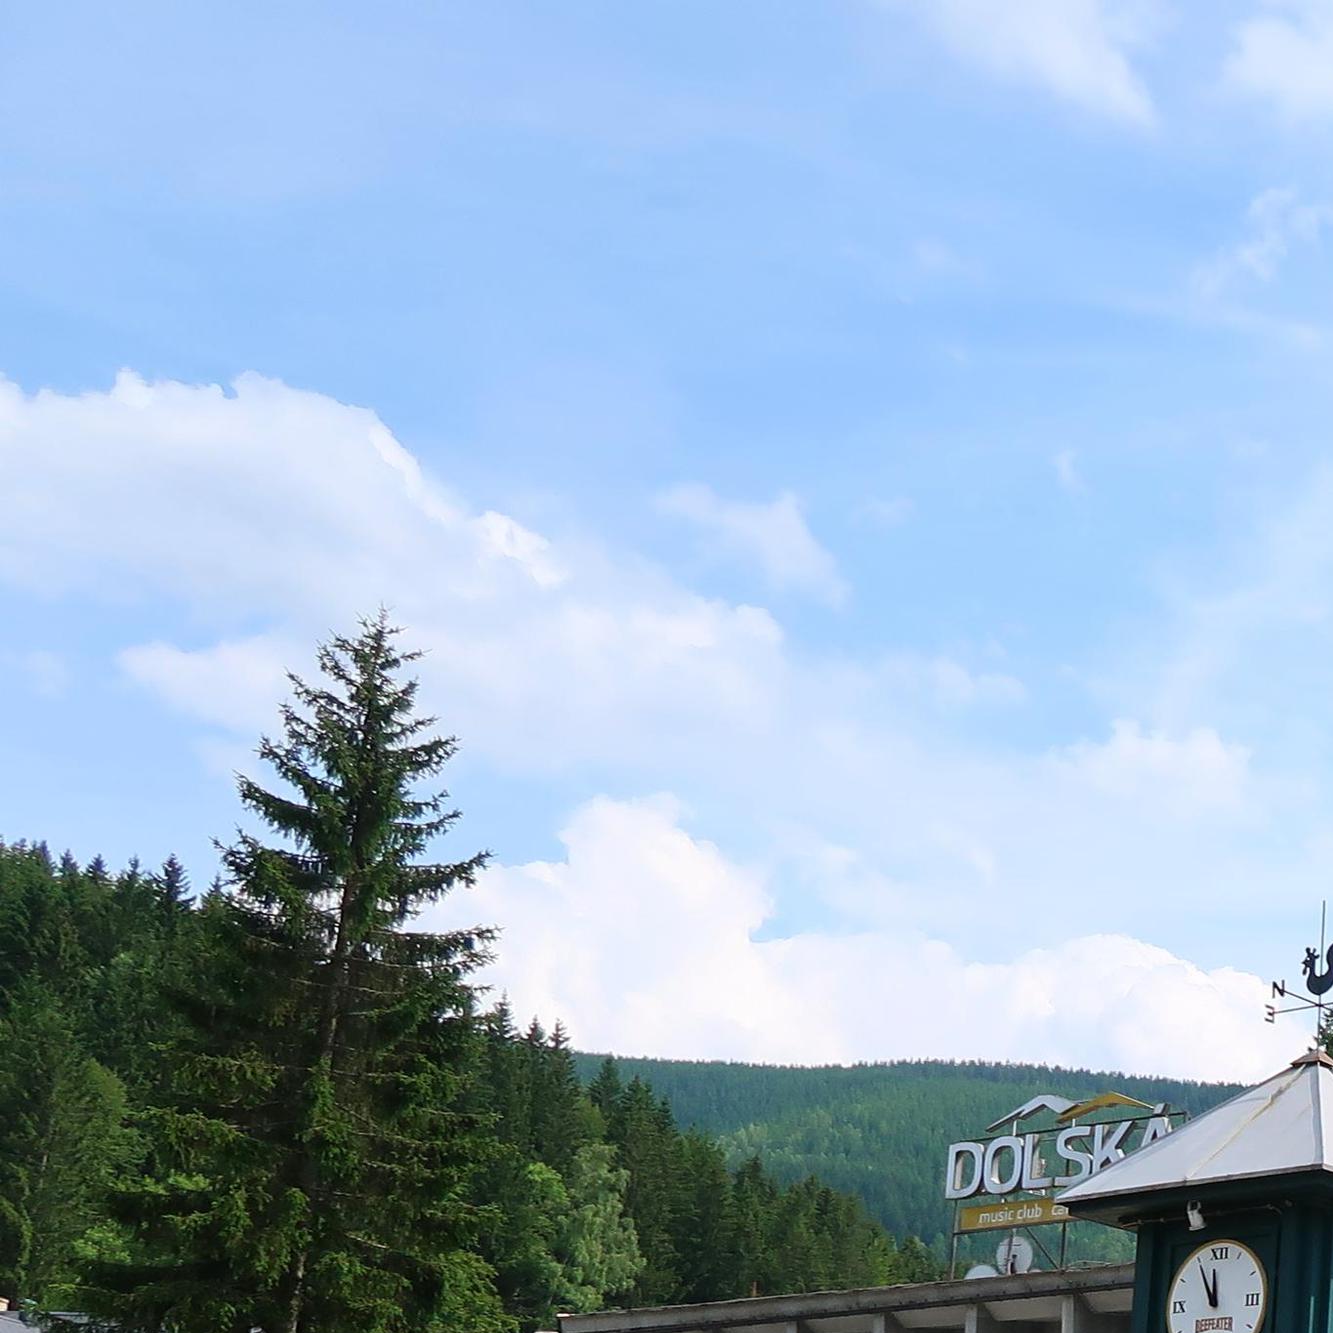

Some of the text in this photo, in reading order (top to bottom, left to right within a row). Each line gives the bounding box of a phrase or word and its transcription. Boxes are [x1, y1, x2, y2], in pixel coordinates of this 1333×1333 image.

[979, 1207, 1015, 1223] music
[1017, 1203, 1042, 1219] club
[1210, 1247, 1229, 1260] XII
[1173, 1293, 1260, 1314] IX III
[1195, 1317, 1233, 1333] BEEFEATER
